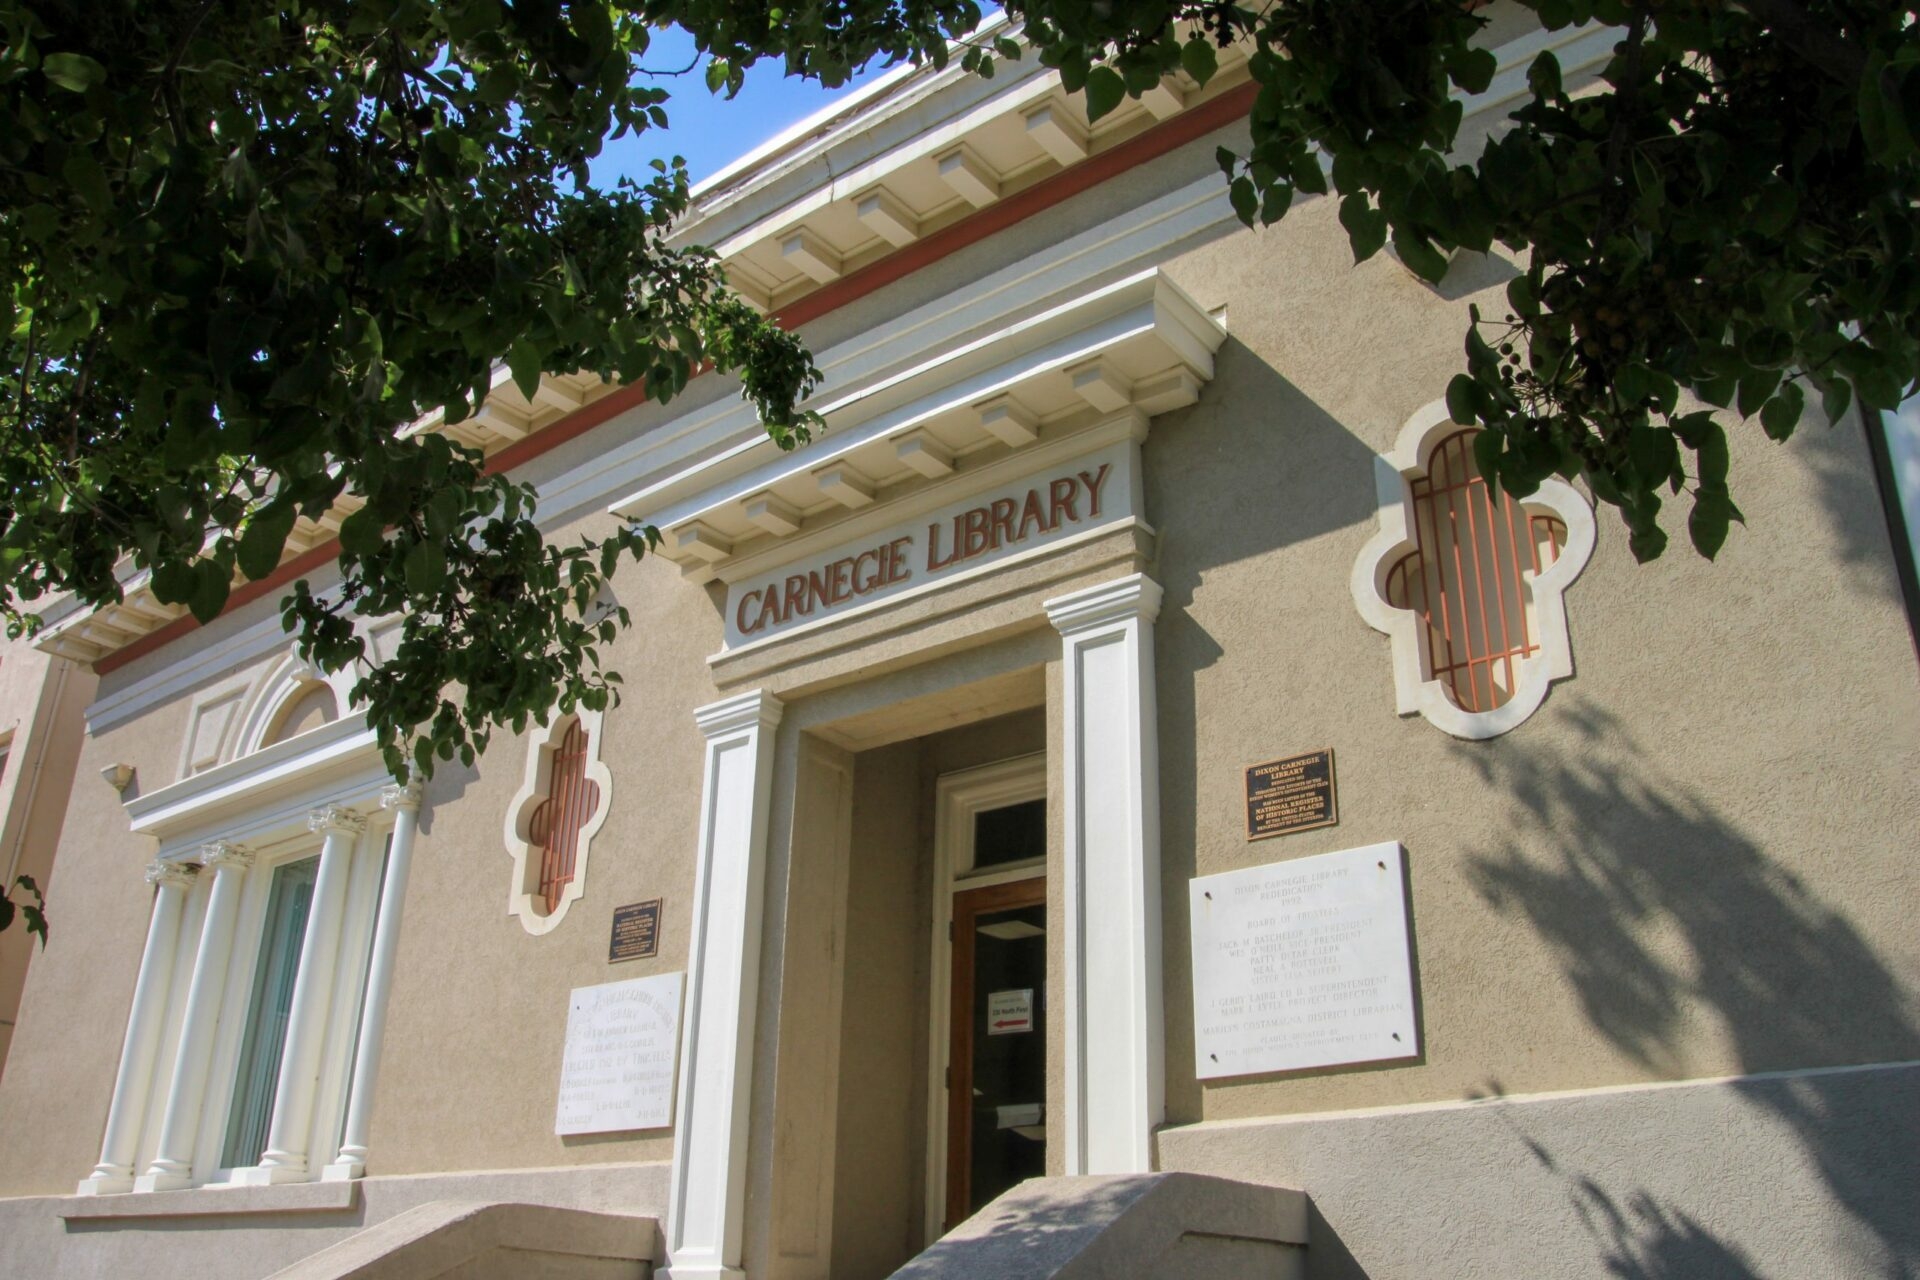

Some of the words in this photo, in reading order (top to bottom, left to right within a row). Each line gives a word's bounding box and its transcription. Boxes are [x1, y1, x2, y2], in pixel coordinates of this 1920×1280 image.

[736, 535, 912, 635] CARNEGIE
[926, 463, 1112, 572] LIBRARY
[1256, 766, 1279, 776] DIXON
[1281, 757, 1320, 770] CARNEGIE
[1271, 768, 1304, 779] LIBRARY
[1256, 803, 1289, 814] NATIONAL
[1291, 796, 1323, 807] REGISTER
[1266, 808, 1297, 818] HISTORIC
[1300, 802, 1324, 811] PLACES
[1234, 884, 1260, 895] DIXON
[1265, 876, 1306, 889] CARNEGIE
[1312, 868, 1348, 881] LIBRARY
[1260, 883, 1323, 900] REDEDICATION
[1248, 918, 1275, 929] BOARD
[1281, 915, 1290, 924] OF
[1298, 907, 1339, 921] TRUSTEES
[1325, 919, 1373, 933] PRESIDENT
[1309, 976, 1388, 994] SUPERINTENDENT
[1333, 988, 1378, 1002] DIRECTOR
[1308, 1010, 1347, 1022] DISTRICT
[1353, 1004, 1402, 1017] LIBRARIAN
